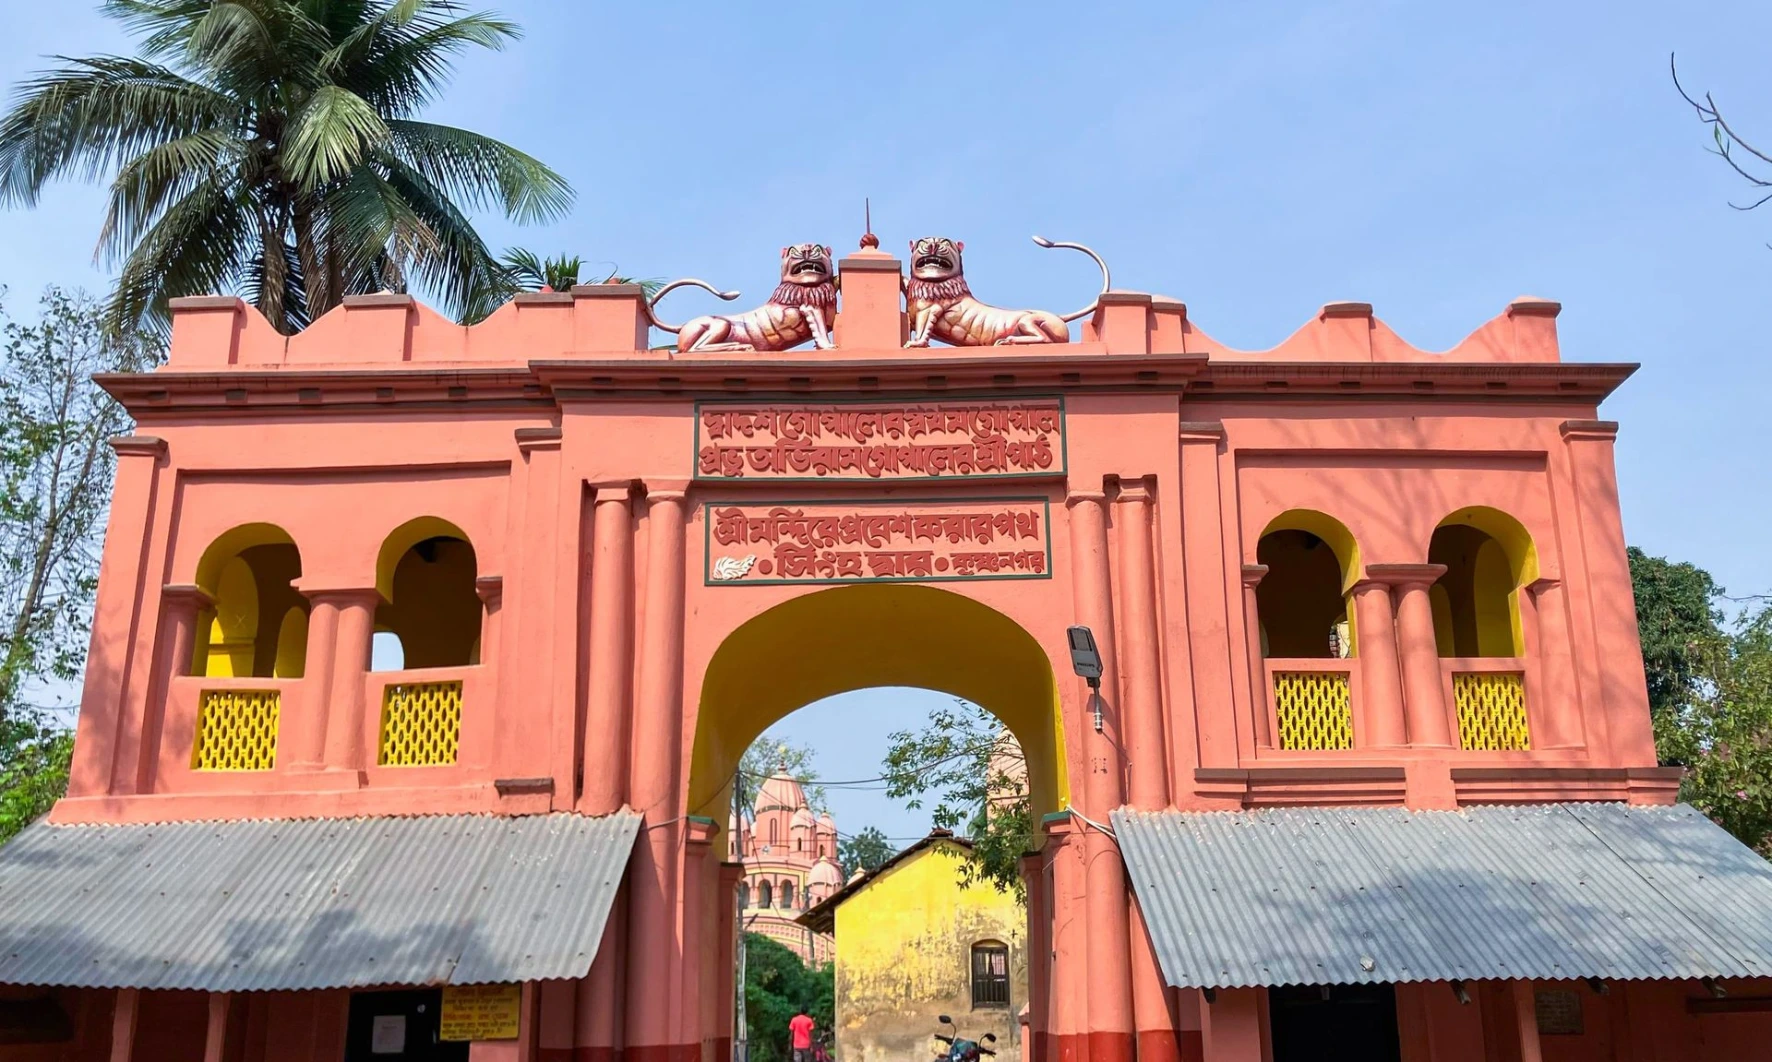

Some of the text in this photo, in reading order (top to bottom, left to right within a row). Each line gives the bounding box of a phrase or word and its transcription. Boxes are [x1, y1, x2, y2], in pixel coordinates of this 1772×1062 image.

[702, 403, 1060, 444] দ্বাদশ গোপালের প্রথম গোপাল
[700, 443, 744, 477] প্রভু
[745, 437, 862, 476] অভিরাম
[862, 442, 975, 478] গোপালের
[838, 512, 913, 548] প্রবেশ
[913, 513, 994, 545] করার
[992, 509, 1039, 541] পথ
[950, 549, 1045, 575] কৃষ্ণনগর
